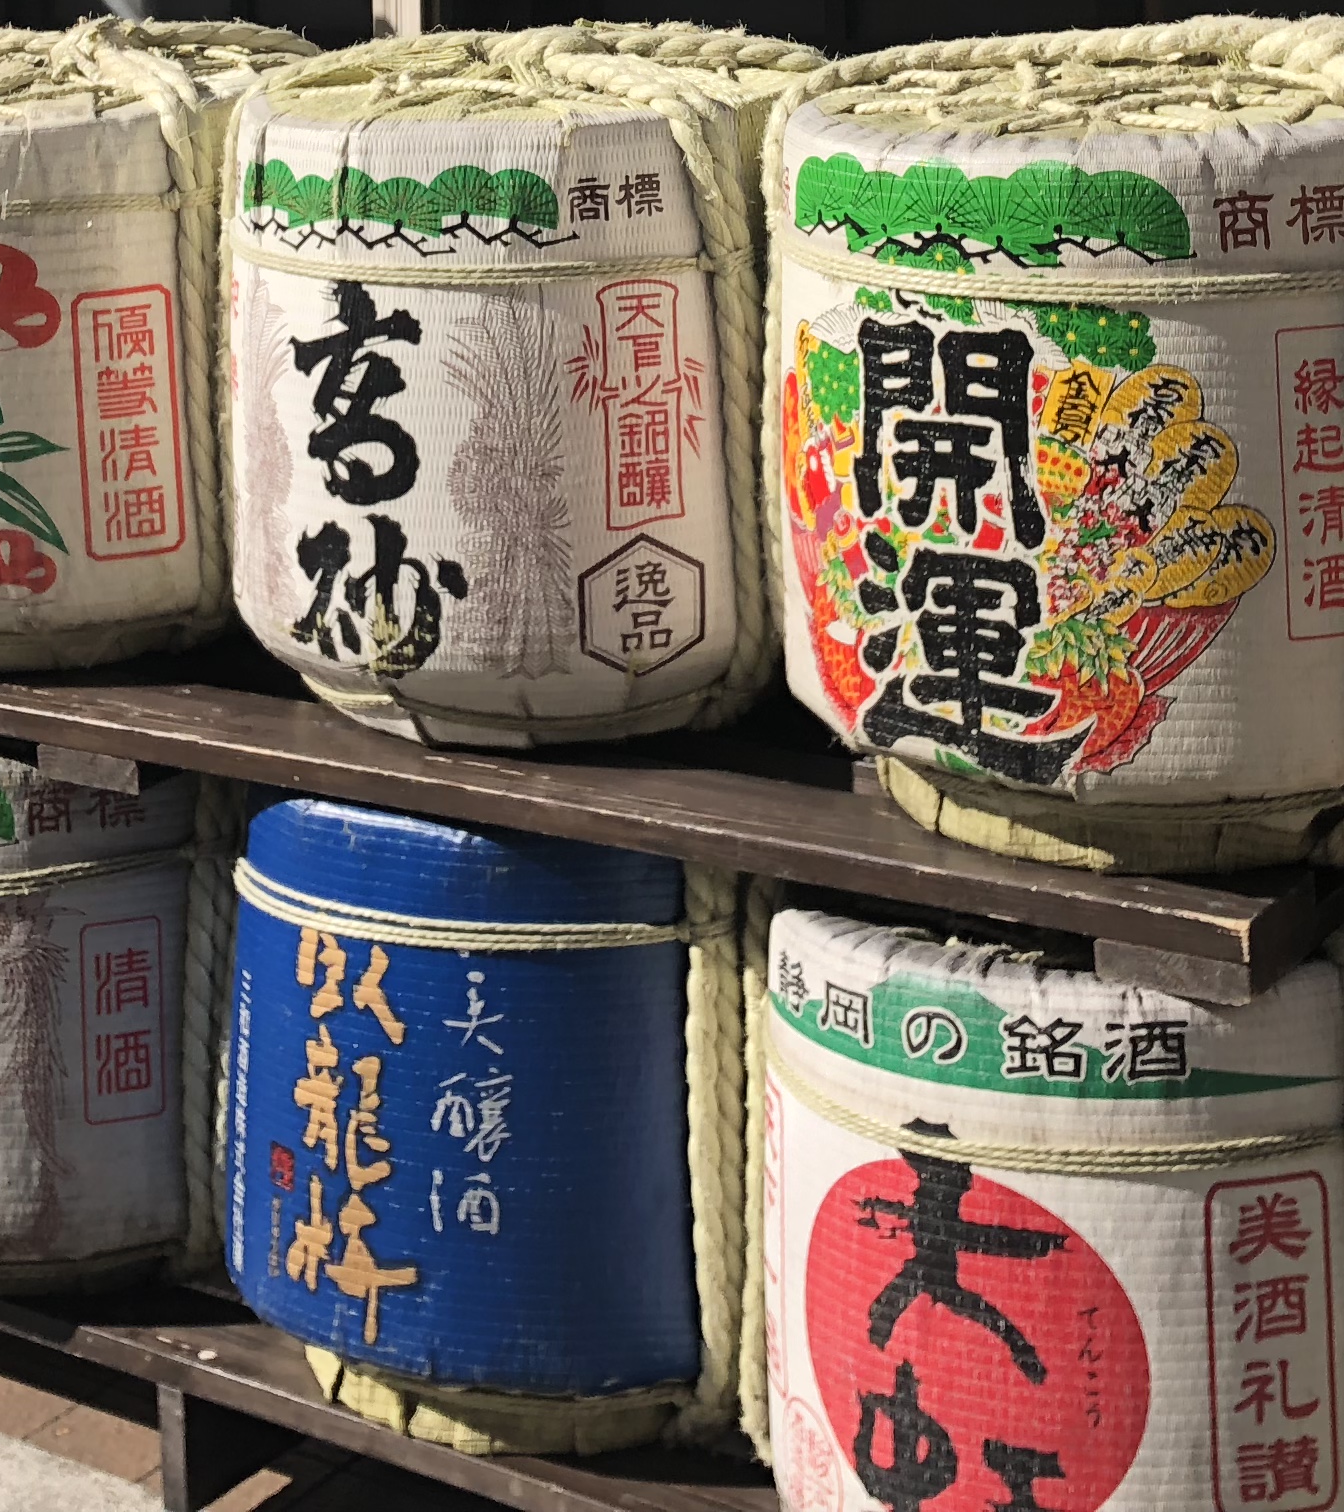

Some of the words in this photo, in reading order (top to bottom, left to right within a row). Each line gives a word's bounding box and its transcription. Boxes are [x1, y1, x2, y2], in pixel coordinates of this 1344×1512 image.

[568, 172, 664, 224] 商標
[613, 560, 678, 653] 逸品
[853, 316, 1092, 787] 開運
[92, 947, 154, 1097] 清酒
[778, 950, 1190, 1081] 静岡の銘酒
